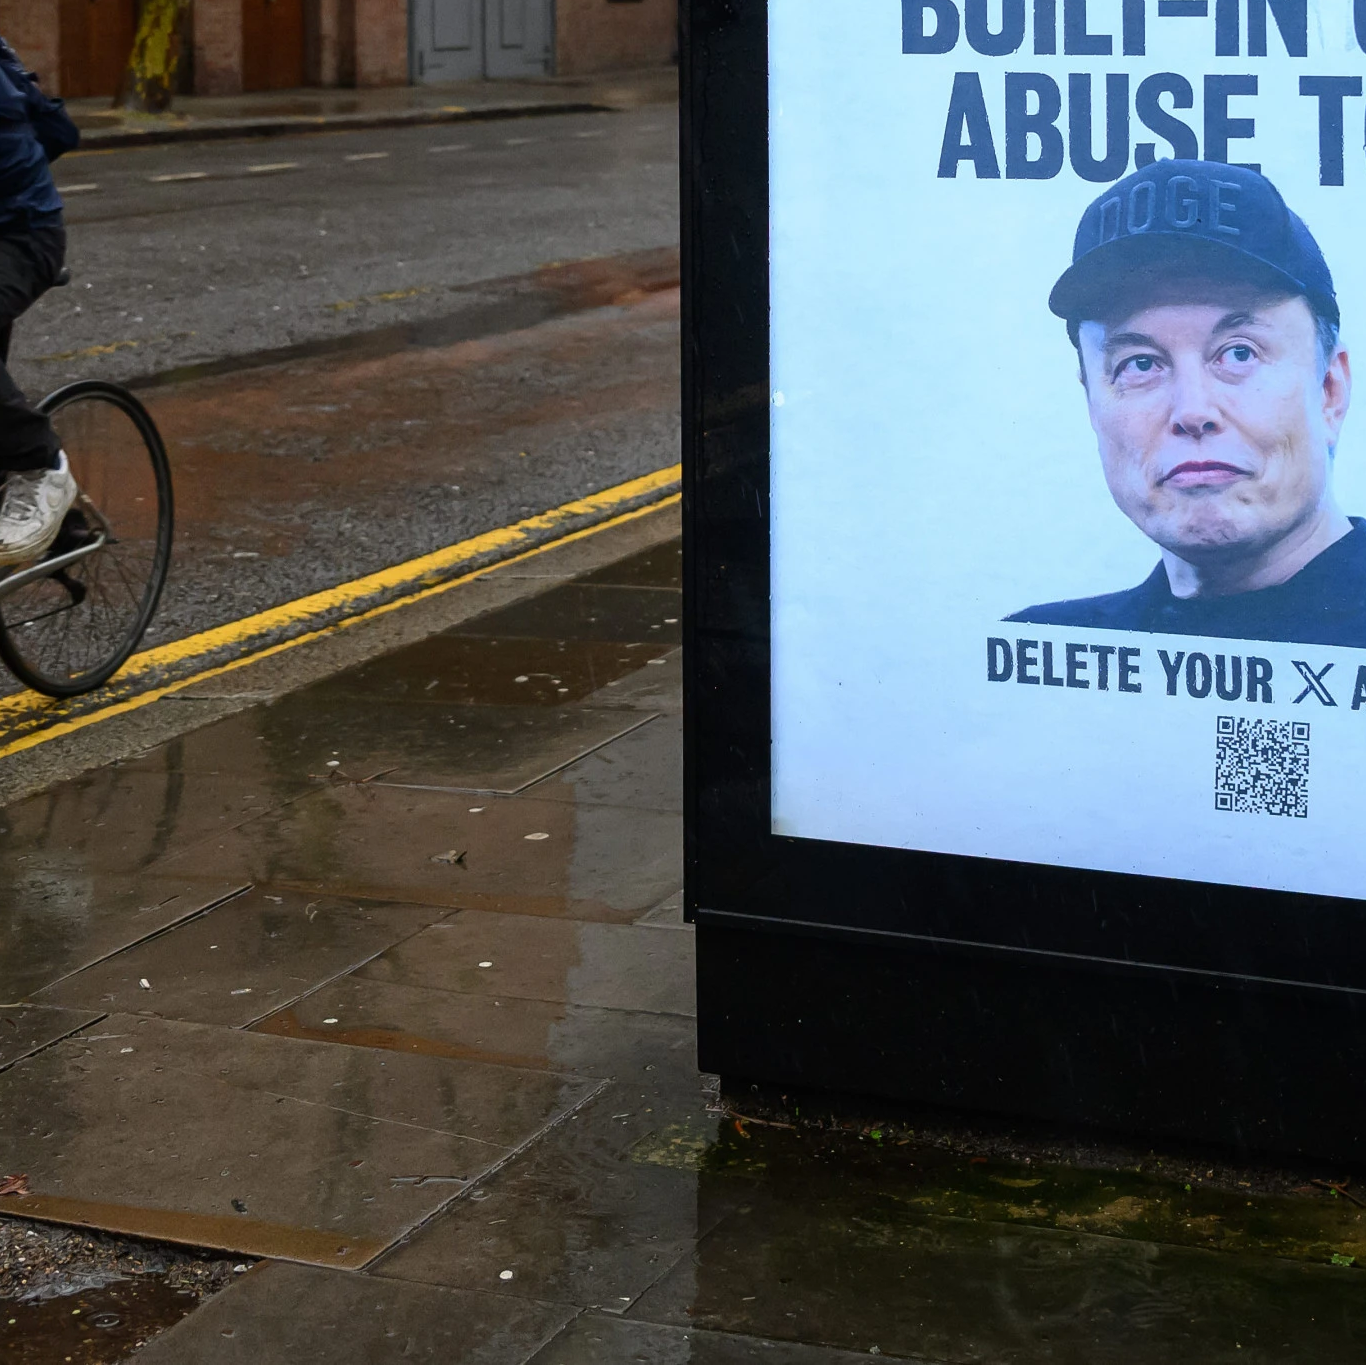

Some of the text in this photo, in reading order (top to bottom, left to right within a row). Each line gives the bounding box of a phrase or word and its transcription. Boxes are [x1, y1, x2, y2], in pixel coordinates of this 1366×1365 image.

[935, 70, 1263, 184] ABUSE
[1098, 174, 1243, 245] DOGE
[985, 636, 1143, 694] DELETE
[1156, 649, 1275, 705] YOUR
[1290, 659, 1340, 709] X
